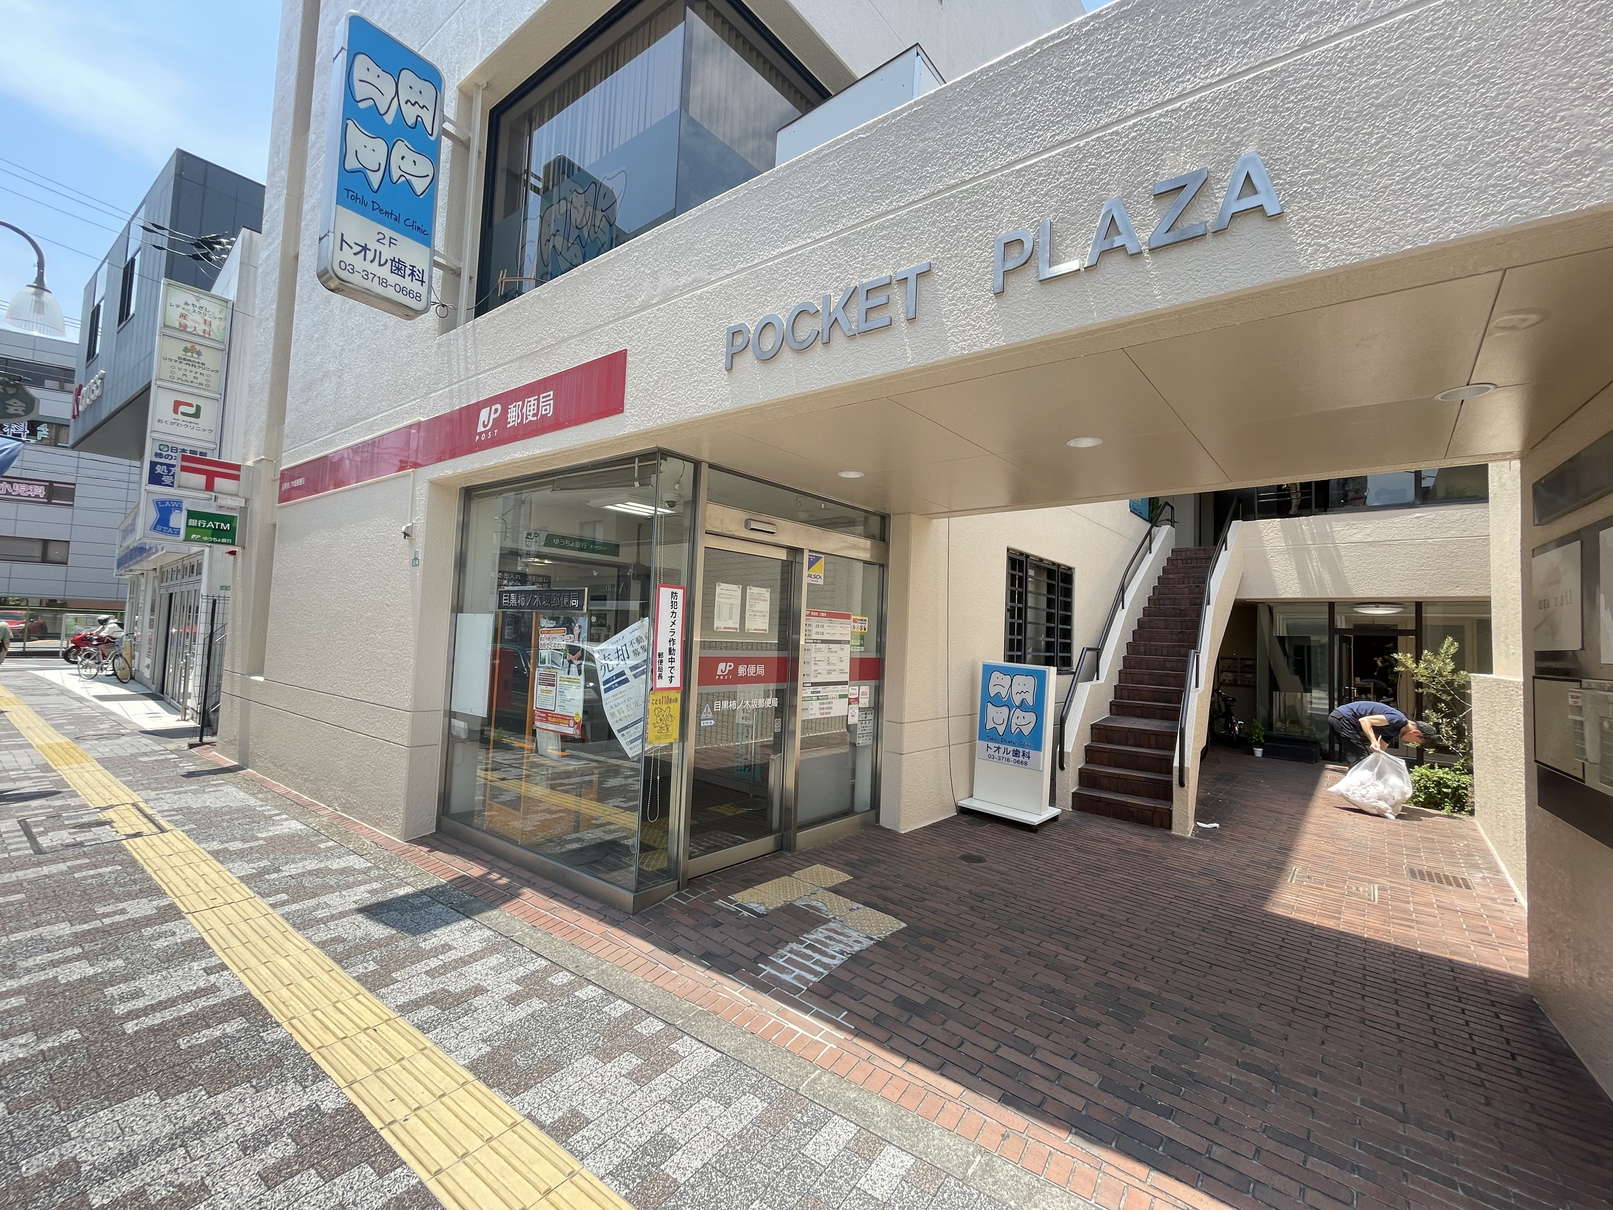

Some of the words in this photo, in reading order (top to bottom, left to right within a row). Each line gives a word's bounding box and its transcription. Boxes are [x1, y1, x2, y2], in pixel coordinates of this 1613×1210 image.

[371, 200, 401, 223] Dental
[403, 217, 430, 236] Clinic
[376, 231, 399, 248] 2F
[339, 232, 426, 287] トオル歯科
[724, 260, 932, 371] POCKET
[993, 150, 1285, 296] PLAZA
[338, 259, 423, 302] 03-3718-0668
[476, 403, 502, 432] JP
[506, 390, 554, 428] 郵便局
[475, 429, 498, 442] POST
[188, 518, 231, 531] 銀行ATM
[668, 591, 679, 685] 防犯カメラ作動中です
[737, 664, 765, 678] 郵便局
[986, 743, 1031, 760] トオル歯科
